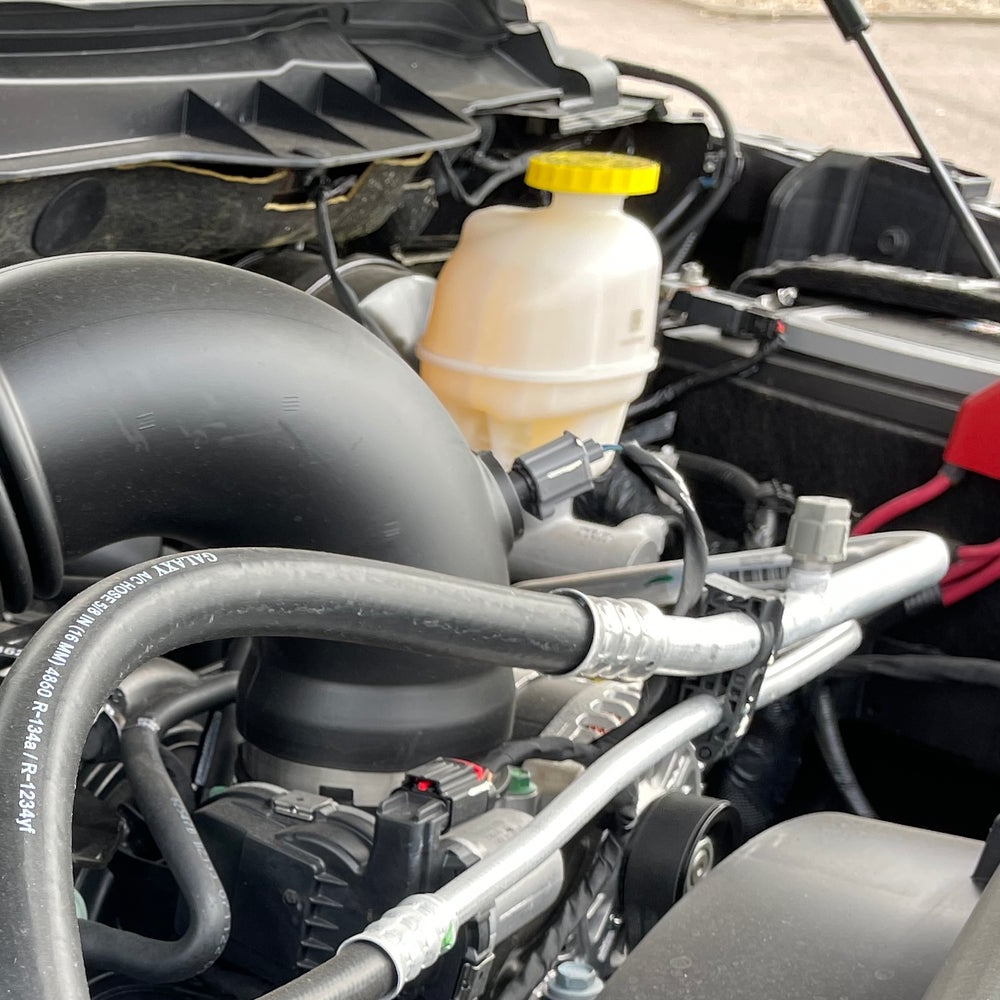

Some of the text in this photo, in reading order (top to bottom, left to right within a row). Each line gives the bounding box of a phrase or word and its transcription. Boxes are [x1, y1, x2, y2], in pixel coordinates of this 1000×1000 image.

[151, 551, 218, 578] GALAXY
[134, 570, 153, 585] A/C
[100, 580, 137, 605] HOSE
[86, 600, 109, 617] 5/8
[75, 615, 96, 628] IN
[63, 625, 86, 644] (16
[47, 641, 75, 667] MM)
[36, 666, 61, 699] 4860
[23, 700, 49, 750] R-134a
[15, 761, 38, 835] R-1234yf
